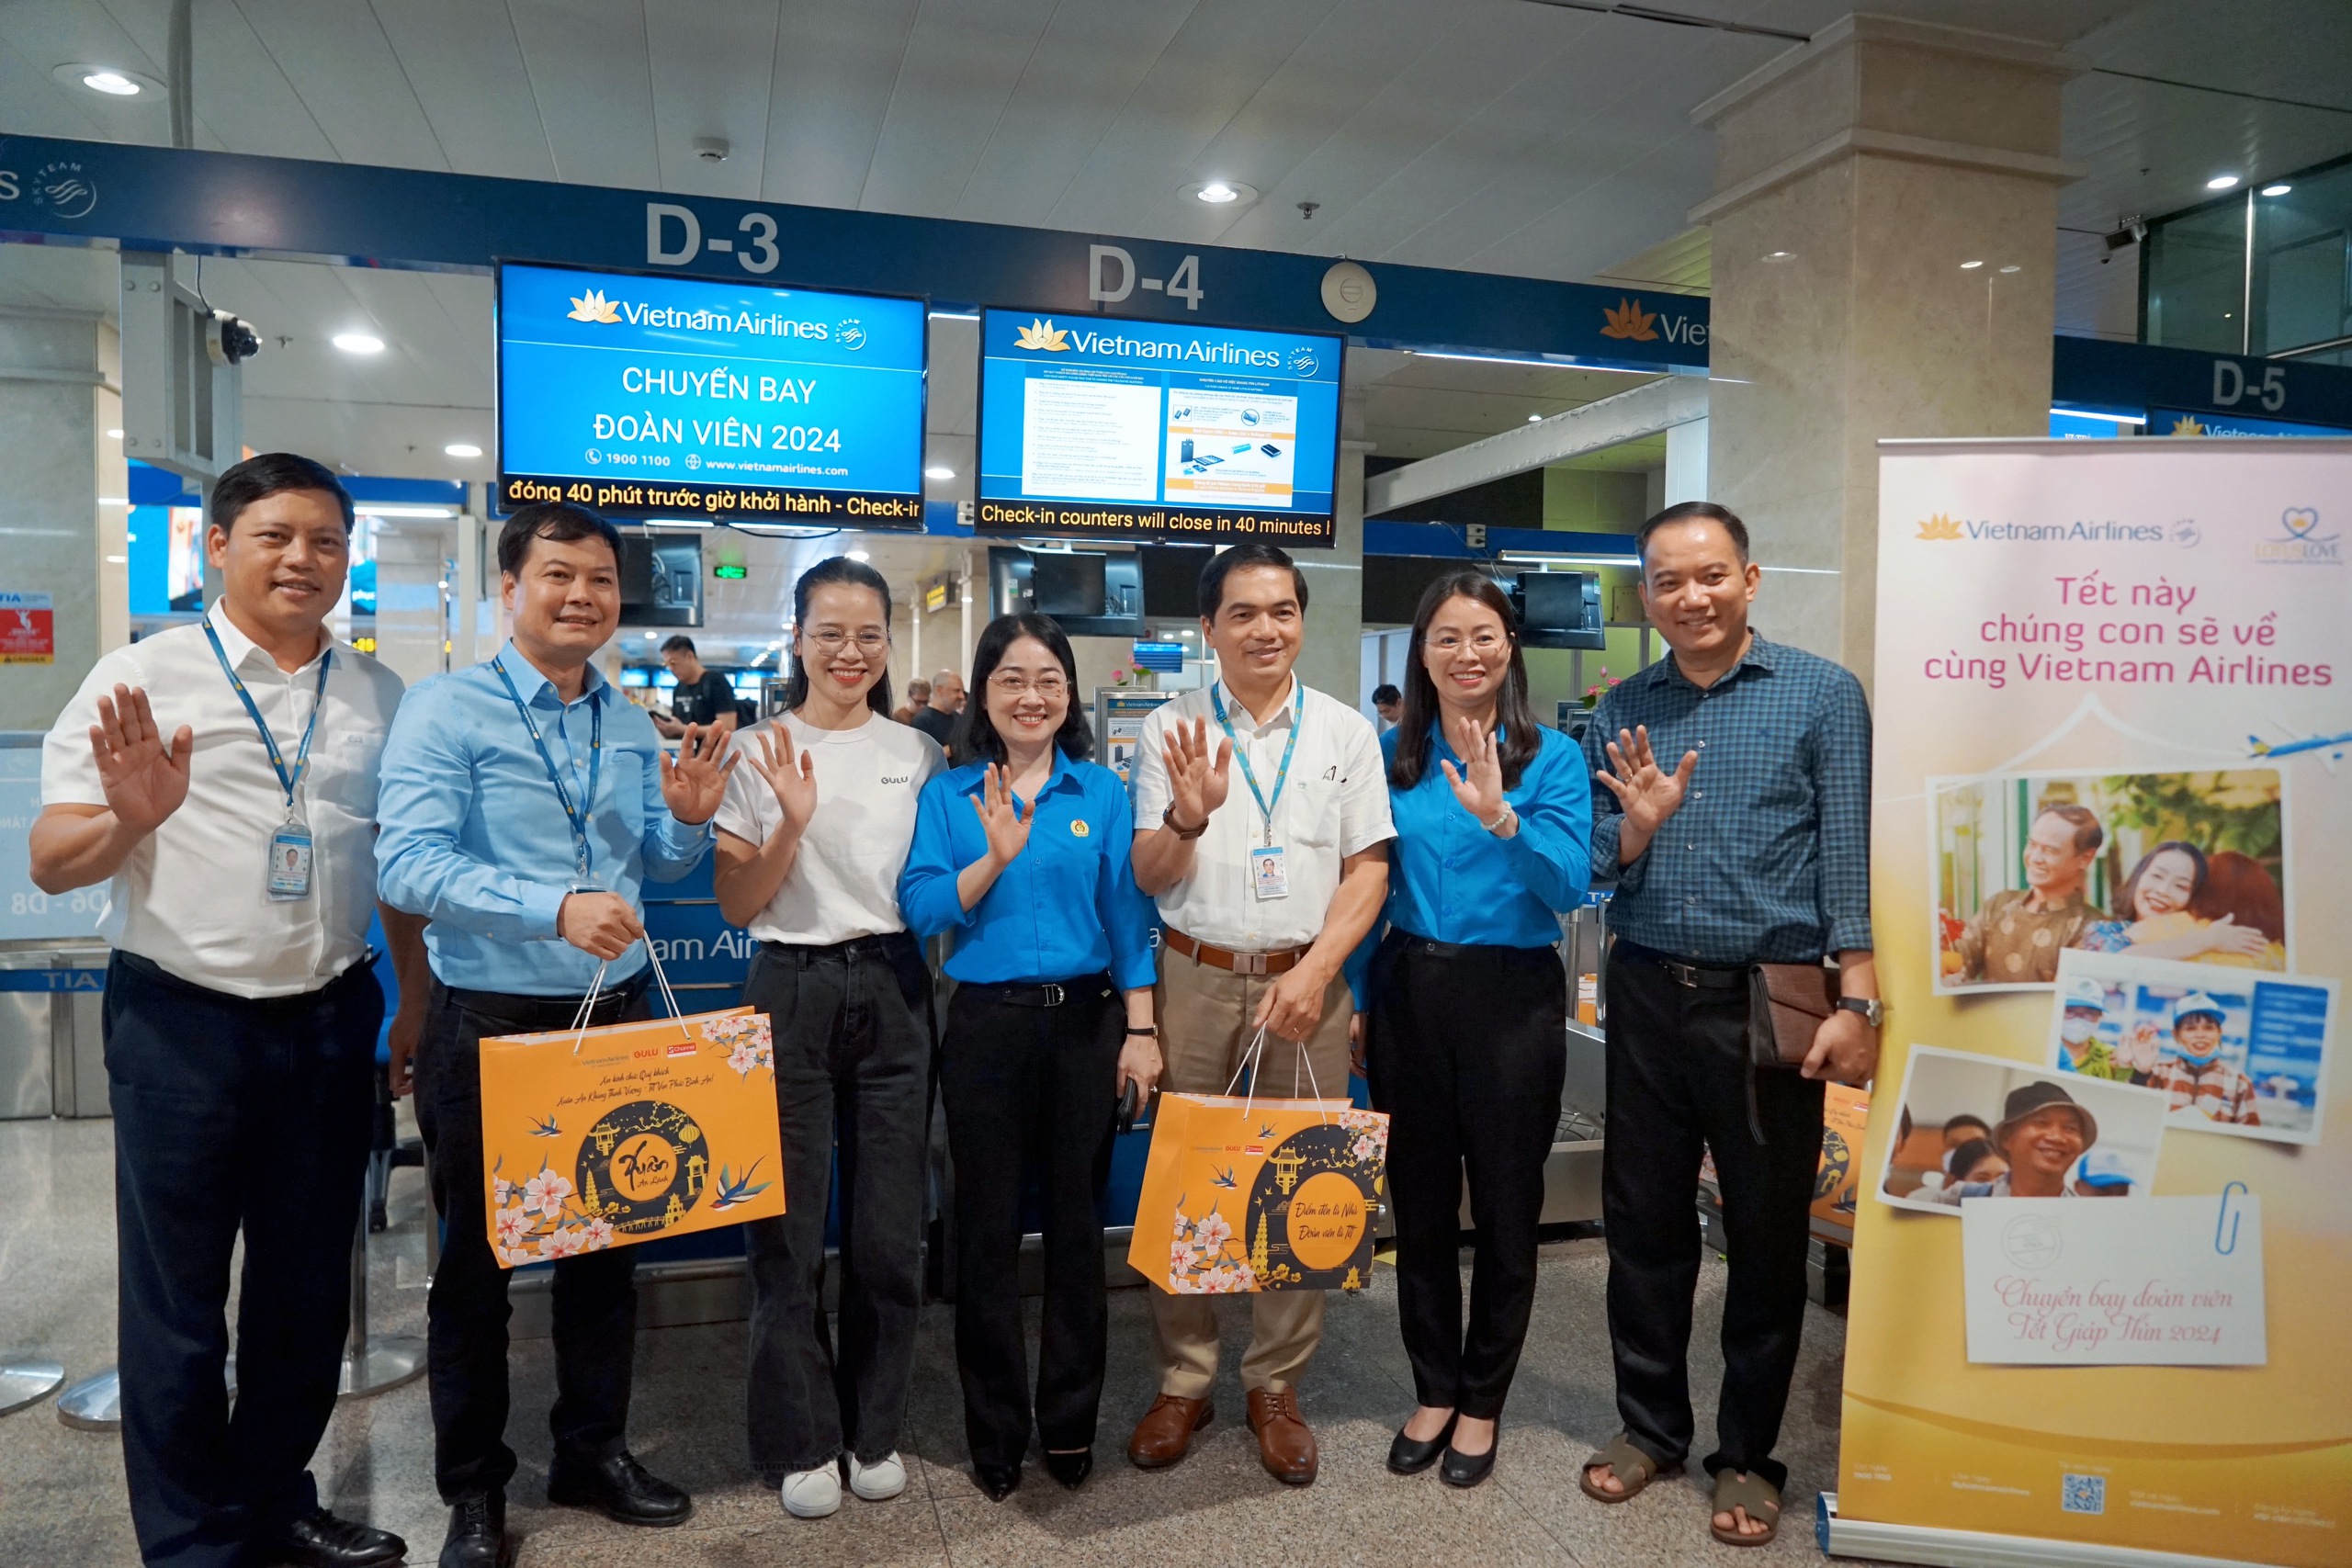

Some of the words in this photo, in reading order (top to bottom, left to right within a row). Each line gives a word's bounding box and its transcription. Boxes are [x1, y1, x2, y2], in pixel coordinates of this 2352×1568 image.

[32, 162, 82, 204] SKYTEAM
[646, 202, 780, 274] D-3
[1089, 244, 1204, 310] D-4
[1660, 313, 1710, 345] Vie
[1287, 346, 1313, 370] SKYTEAM
[622, 367, 749, 400] CHUYẾN
[759, 377, 817, 404] BAY
[2212, 360, 2286, 412] D-5
[593, 412, 684, 445] ĐOÀN
[692, 417, 763, 448] VIÊN
[771, 425, 842, 453] 2024
[606, 452, 638, 466] 1900
[641, 455, 671, 468] 1100
[706, 458, 848, 477] www.vietnamairlines.com
[508, 479, 561, 502] đóng
[566, 483, 593, 502] 40
[598, 484, 643, 508] phút
[647, 487, 701, 508] trước
[706, 489, 737, 513] giờ
[741, 491, 781, 512] khởi
[786, 493, 831, 514] hành
[981, 505, 1055, 527] Check-in
[1059, 511, 1133, 529] counters
[1137, 513, 1165, 529] will
[1169, 513, 1213, 532] close
[1216, 515, 1231, 532] in
[1235, 516, 1255, 533] 40
[1260, 518, 1321, 536] minutes
[2054, 570, 2117, 606] Tết
[2132, 576, 2197, 615] này
[1980, 613, 2084, 652] chúng
[2098, 620, 2164, 644] con
[2177, 616, 2219, 646] sẽ
[2233, 610, 2278, 647] về
[1924, 649, 2006, 689] cùng
[2018, 653, 2174, 683] Vietnam
[2187, 655, 2332, 686] Airlines
[881, 776, 909, 784] GULU
[41, 972, 98, 988] TIA
[634, 1049, 659, 1058] GULU
[2088, 1279, 2128, 1316] bay
[2169, 1325, 2222, 1346] 2024
